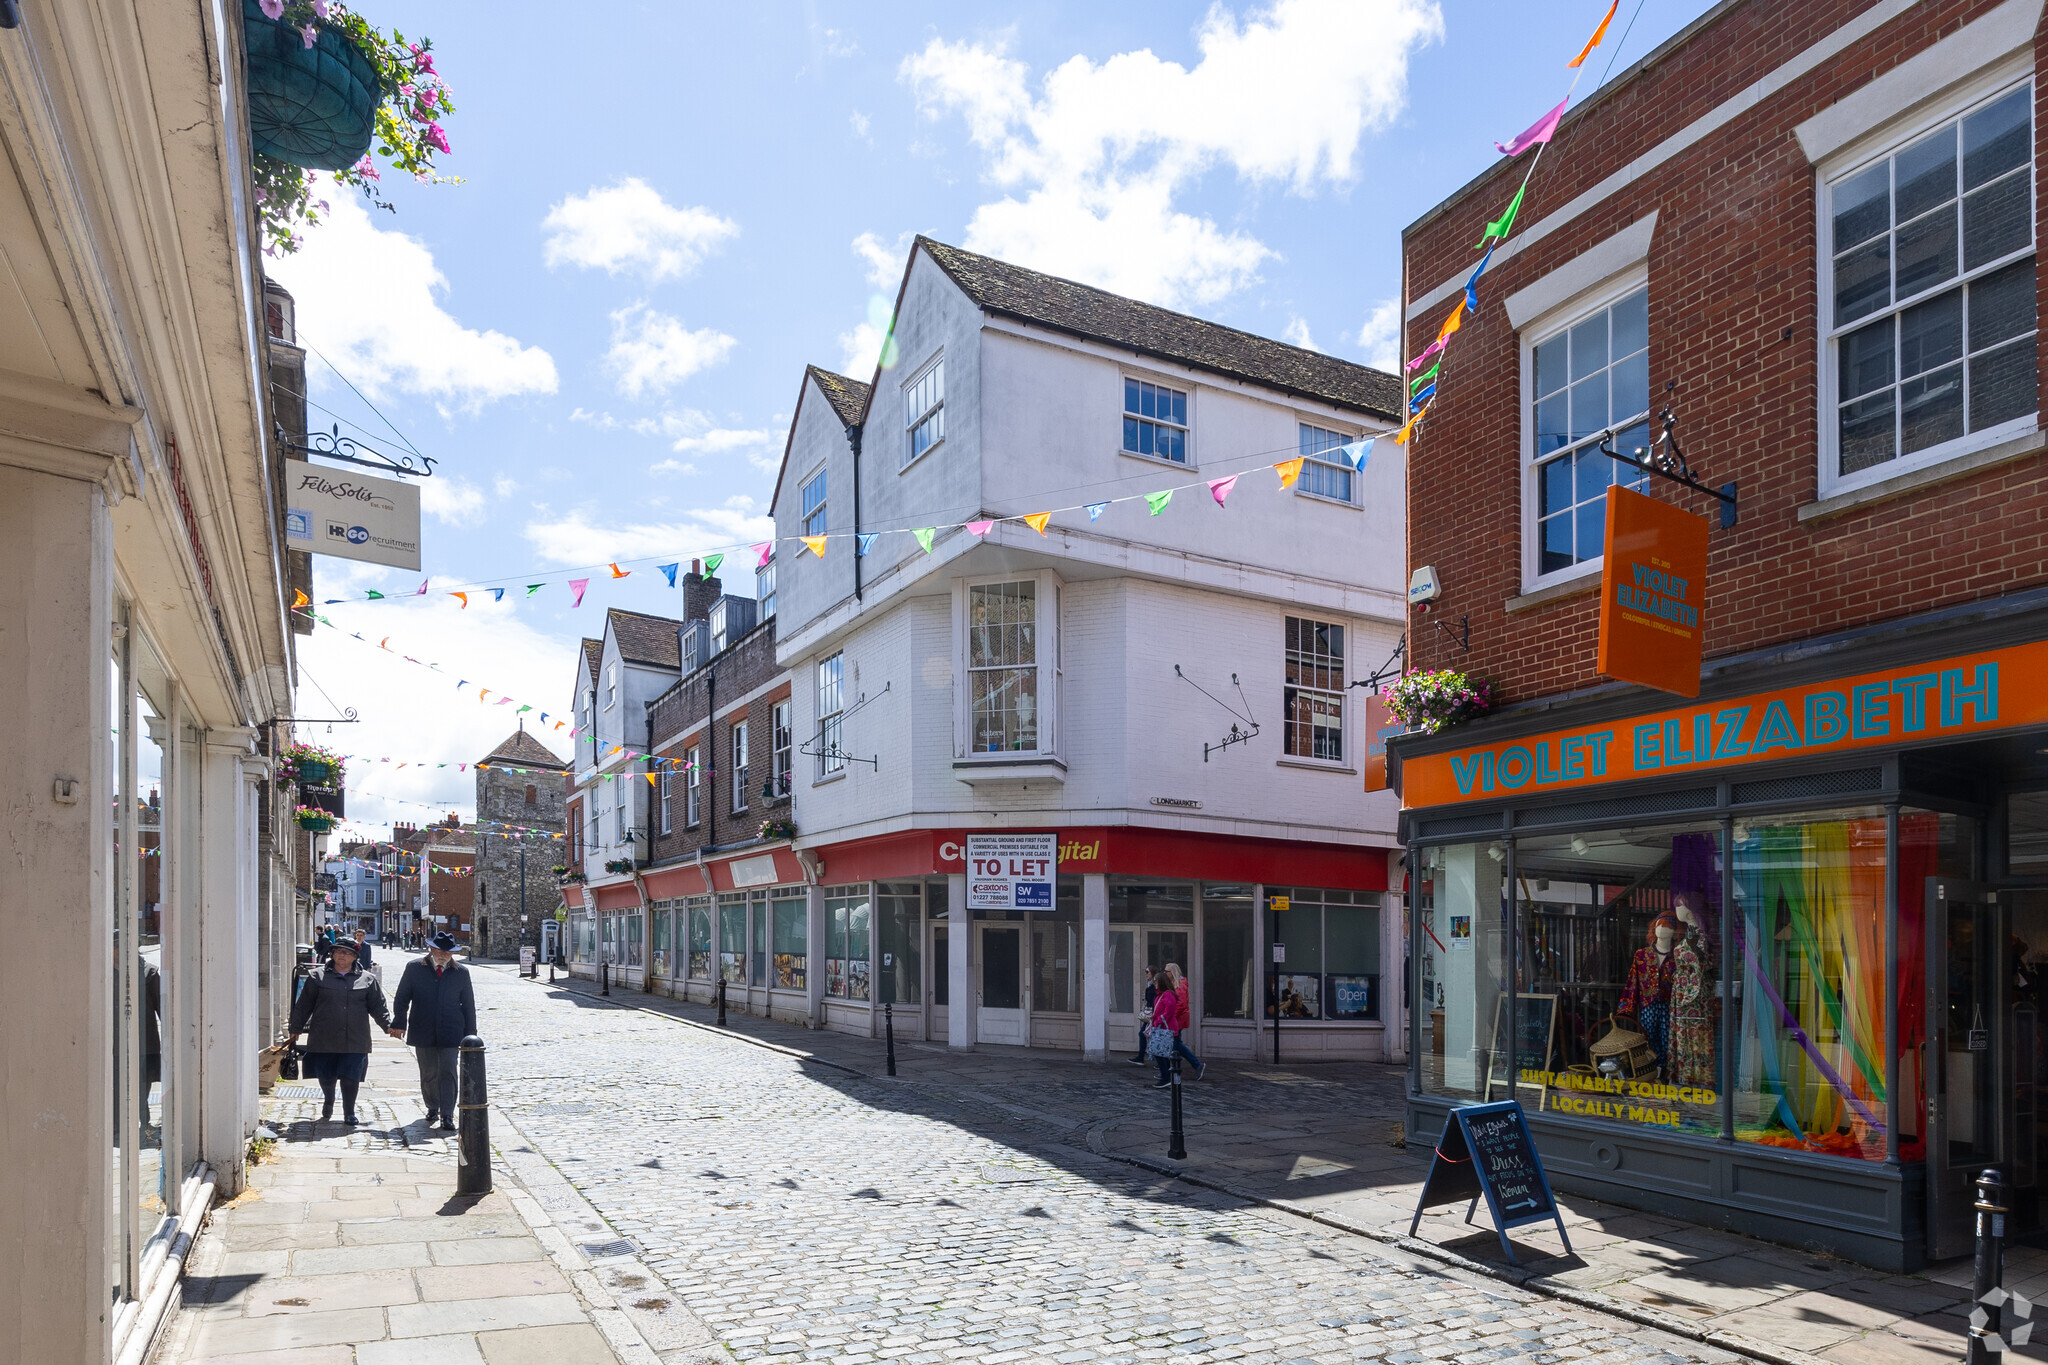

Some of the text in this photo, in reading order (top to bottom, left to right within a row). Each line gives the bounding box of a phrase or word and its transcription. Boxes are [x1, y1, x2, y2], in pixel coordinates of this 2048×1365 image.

[329, 525, 416, 549] HR GO recruitment
[1410, 582, 1432, 596] SECOM
[1632, 562, 1688, 600] VIOLET
[1617, 584, 1698, 628] ELIZABETH
[1622, 612, 1650, 627] COLOURFUL
[1653, 621, 1671, 633] ETHICAL
[1290, 700, 1335, 714] SLATER
[1449, 662, 1999, 795] VIOLET ELIZABETH
[1157, 797, 1198, 807] LONGMARKET
[973, 859, 1050, 876] TO LET
[1338, 988, 1367, 1003] Open
[1521, 1068, 1717, 1105] SUSTAINABLY SOURCED
[1552, 1095, 1680, 1127] LOCALLY MADE
[1502, 1133, 1520, 1141] PEOPLE
[1490, 1154, 1526, 1171] Dress
[1500, 1171, 1515, 1179] FOCUS
